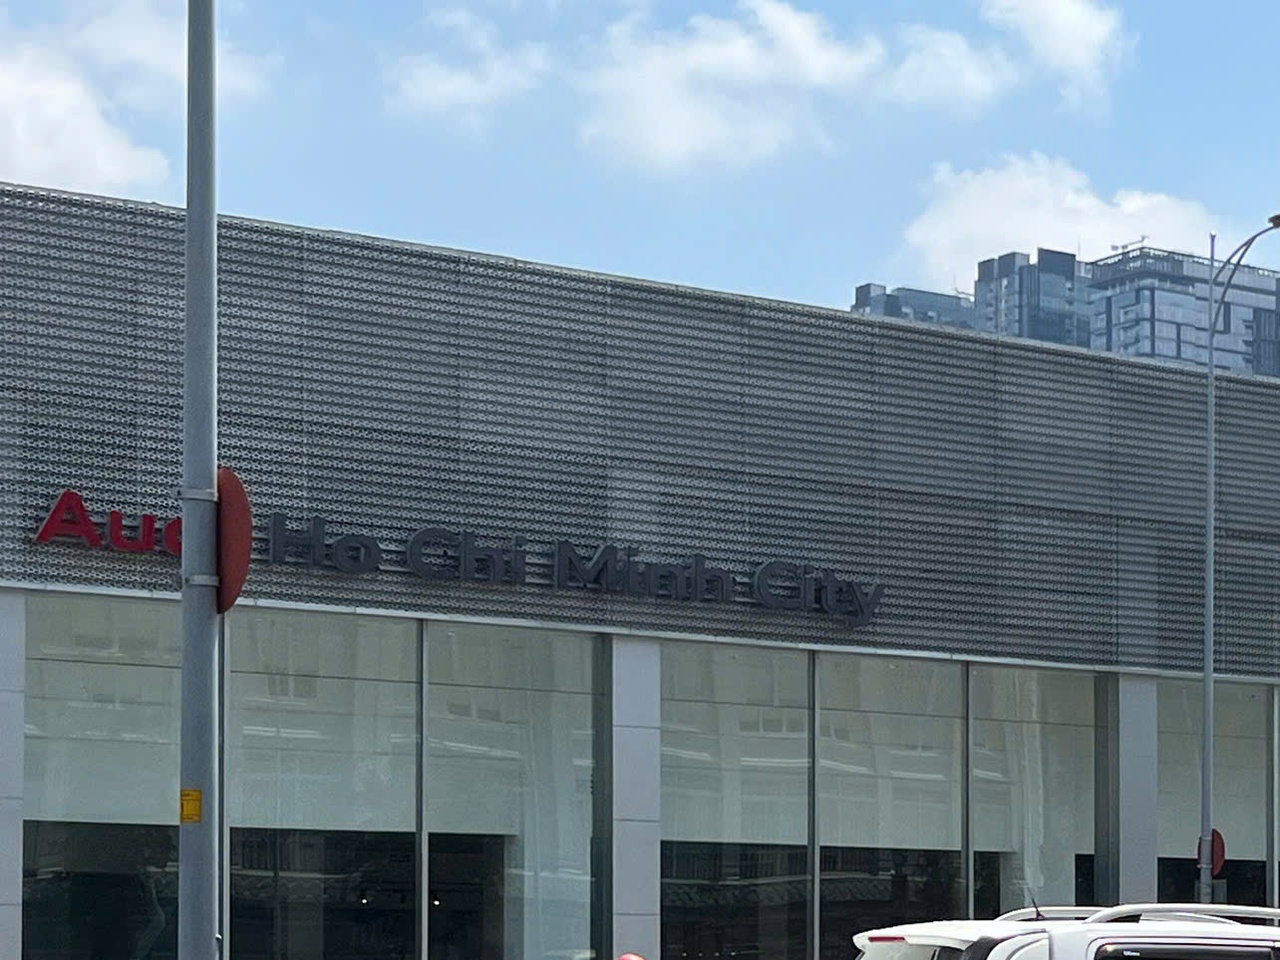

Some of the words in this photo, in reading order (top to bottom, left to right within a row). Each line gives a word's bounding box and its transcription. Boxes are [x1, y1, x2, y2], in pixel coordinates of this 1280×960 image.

[37, 488, 182, 555] Au
[268, 512, 382, 574] Ho
[405, 526, 526, 586] Chi
[553, 539, 733, 602] Minh
[752, 560, 885, 628] City
